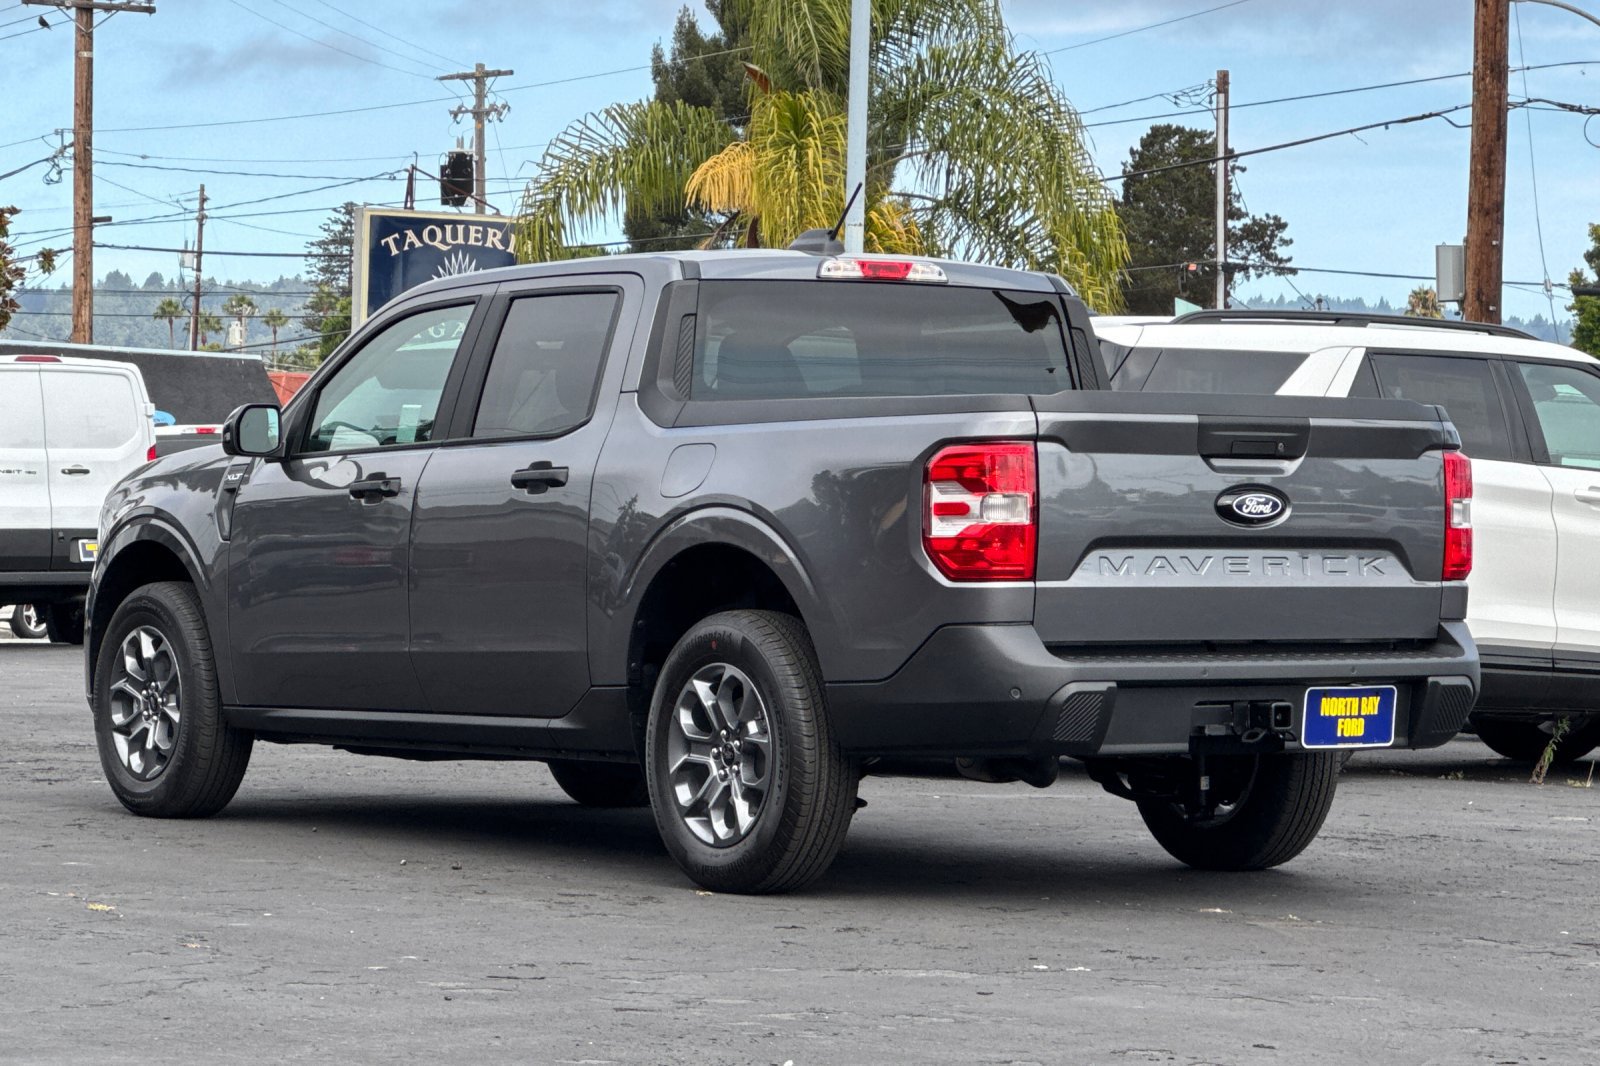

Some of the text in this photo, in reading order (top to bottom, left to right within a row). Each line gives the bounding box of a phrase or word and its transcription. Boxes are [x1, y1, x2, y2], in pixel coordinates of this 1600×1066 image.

[1242, 497, 1272, 513] Ford
[1099, 556, 1386, 577] MAVERICK
[1320, 696, 1380, 716] NORTH BAY
[1337, 718, 1365, 737] FORD
